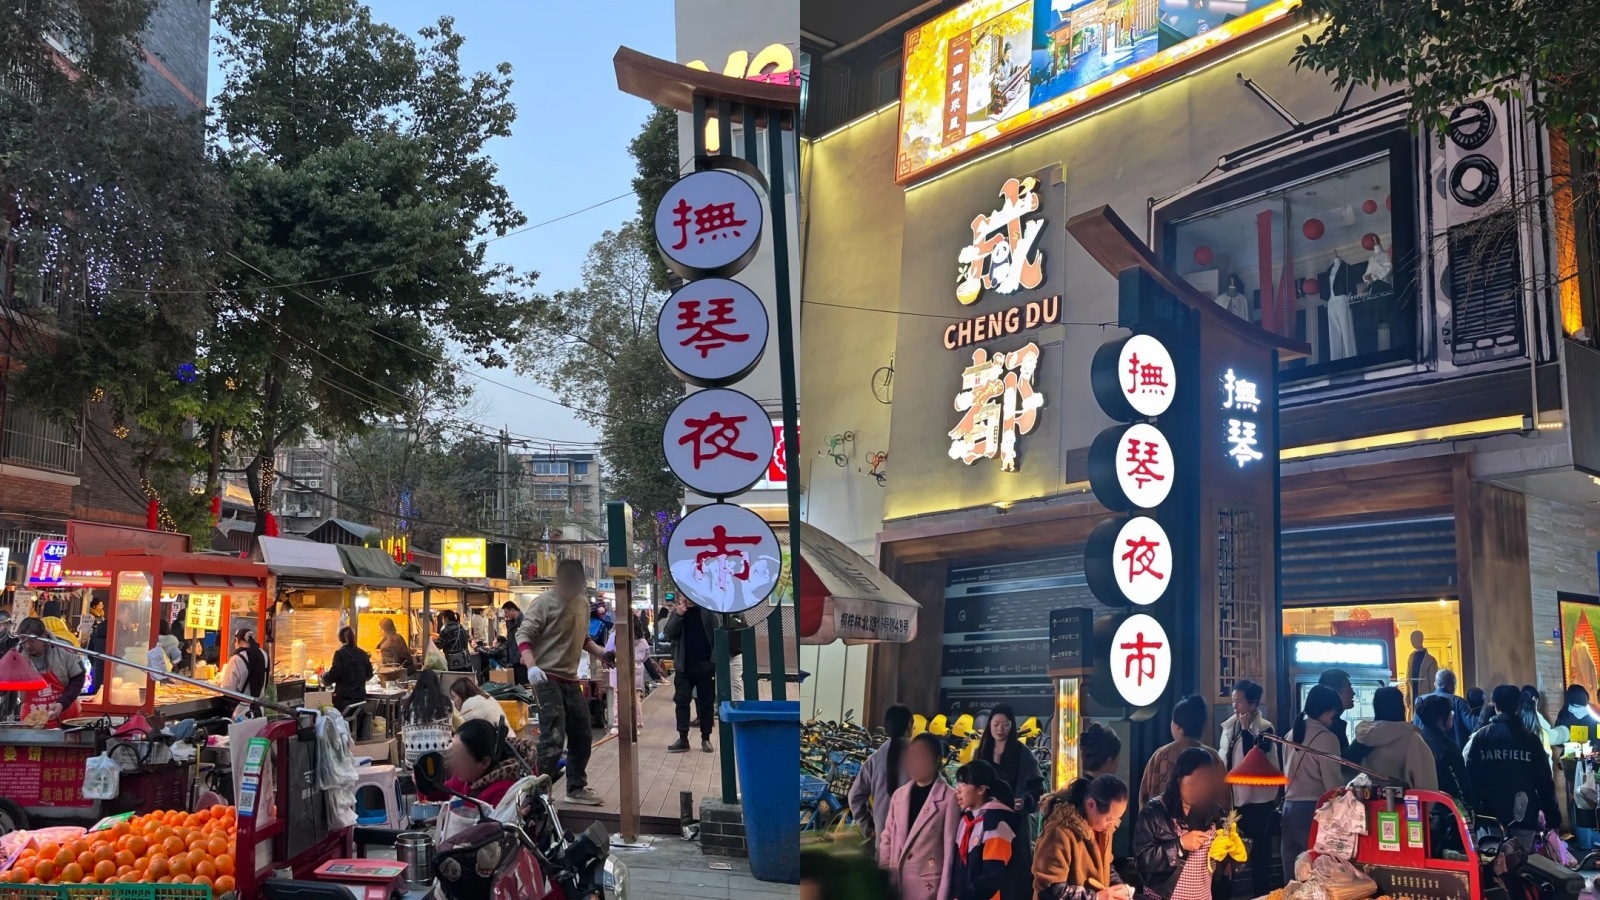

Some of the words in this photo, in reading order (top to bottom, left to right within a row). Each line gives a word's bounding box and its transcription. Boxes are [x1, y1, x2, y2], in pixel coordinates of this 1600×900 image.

[943, 307, 1020, 350] CHENG
[1024, 295, 1059, 330] DU
[672, 199, 762, 590] 撫琴夜市
[1222, 367, 1263, 468] 撫琴
[1120, 351, 1169, 687] 撫琴夜市
[190, 593, 203, 626] 巴土豆
[41, 786, 74, 802] 葱油饼
